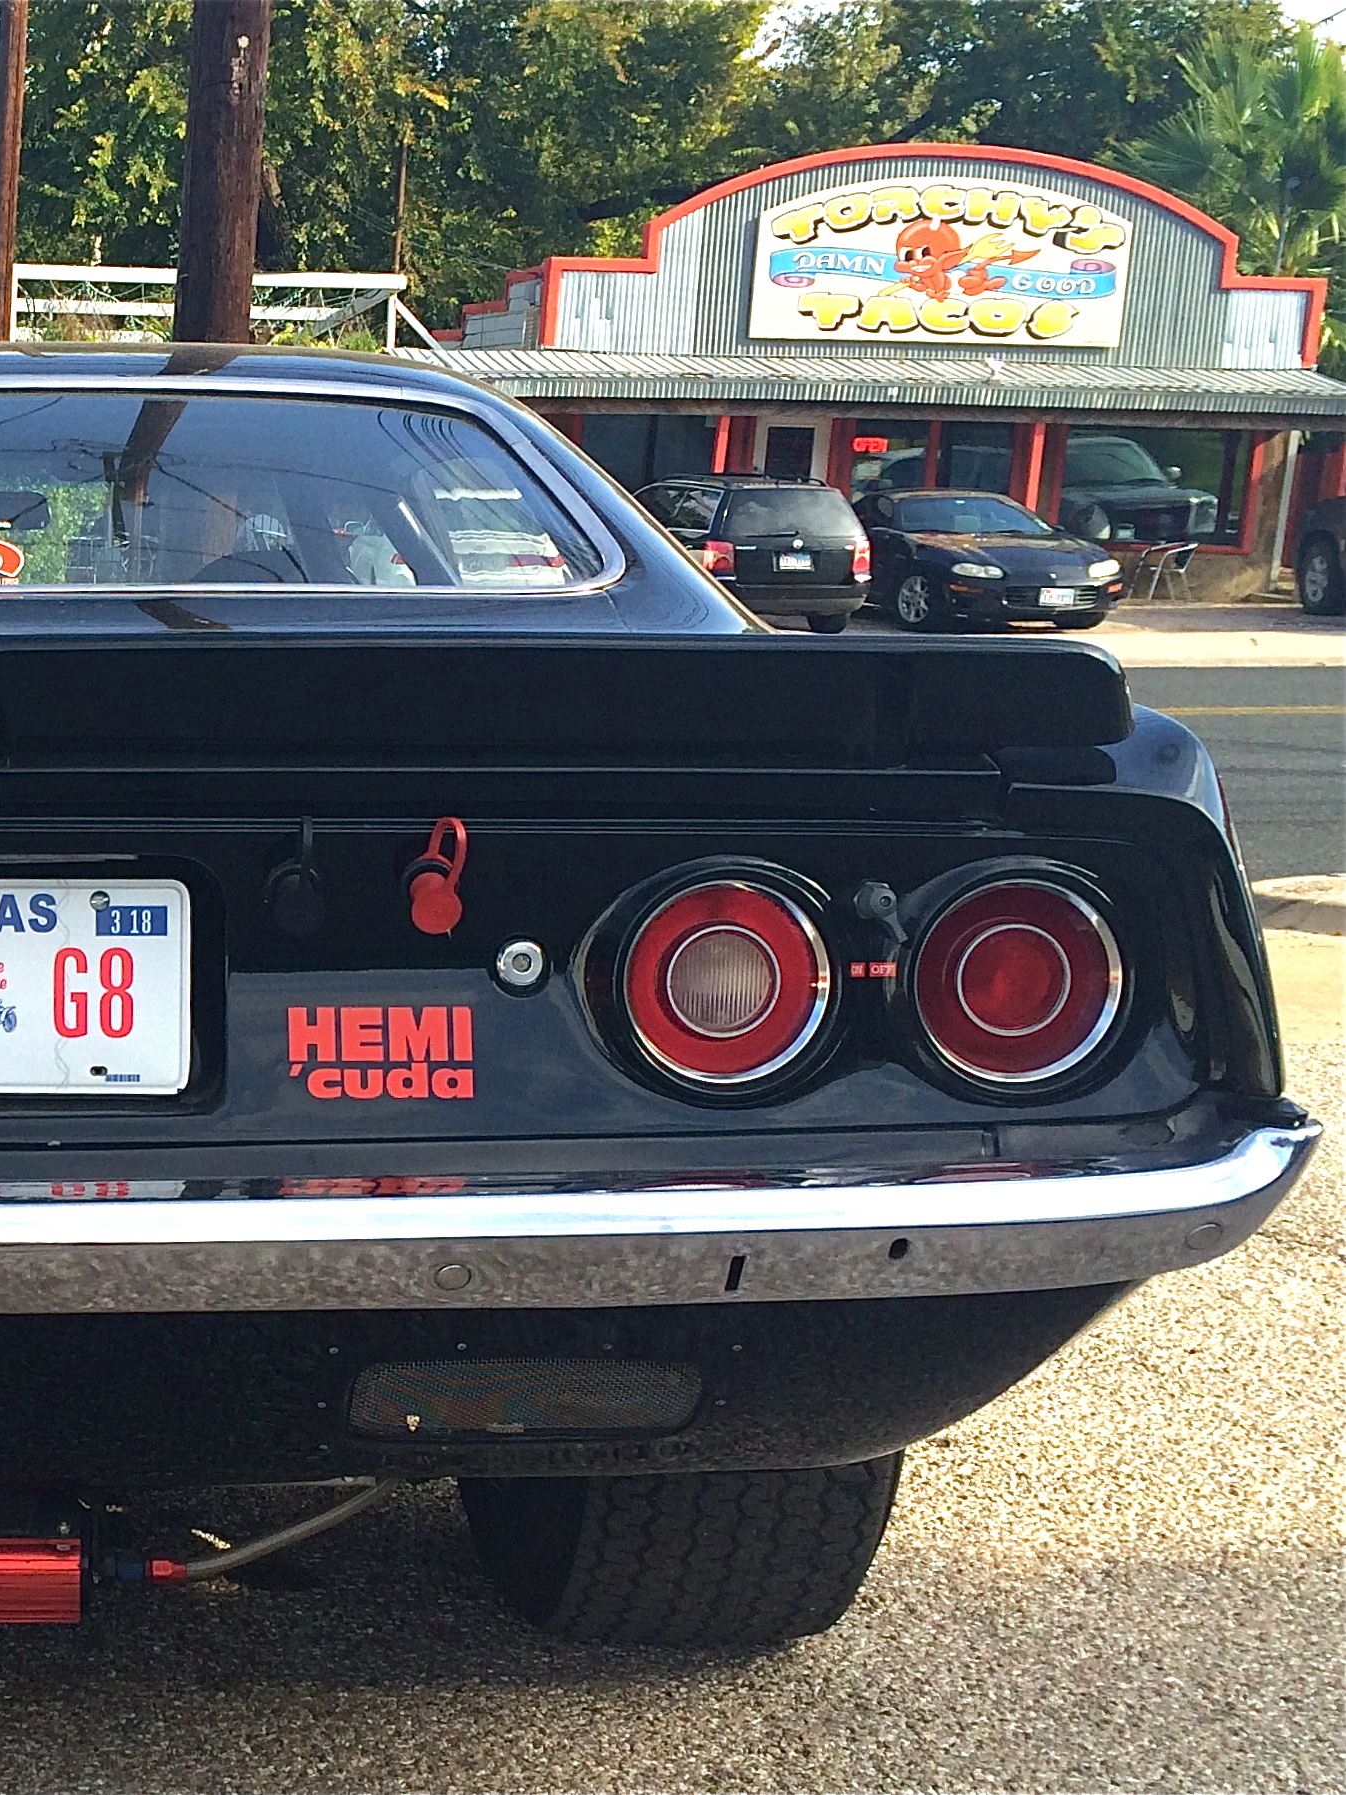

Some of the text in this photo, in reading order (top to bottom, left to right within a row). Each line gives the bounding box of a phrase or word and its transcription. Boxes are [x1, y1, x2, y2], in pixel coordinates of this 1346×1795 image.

[771, 185, 1127, 254] TORCHY'S
[792, 251, 1096, 295] DAMN GOOD
[798, 291, 1081, 339] TACOS
[110, 909, 152, 934] 3 18
[53, 947, 134, 1038] G8
[287, 1006, 474, 1061] HEMI
[289, 1062, 474, 1098] 'cuda
